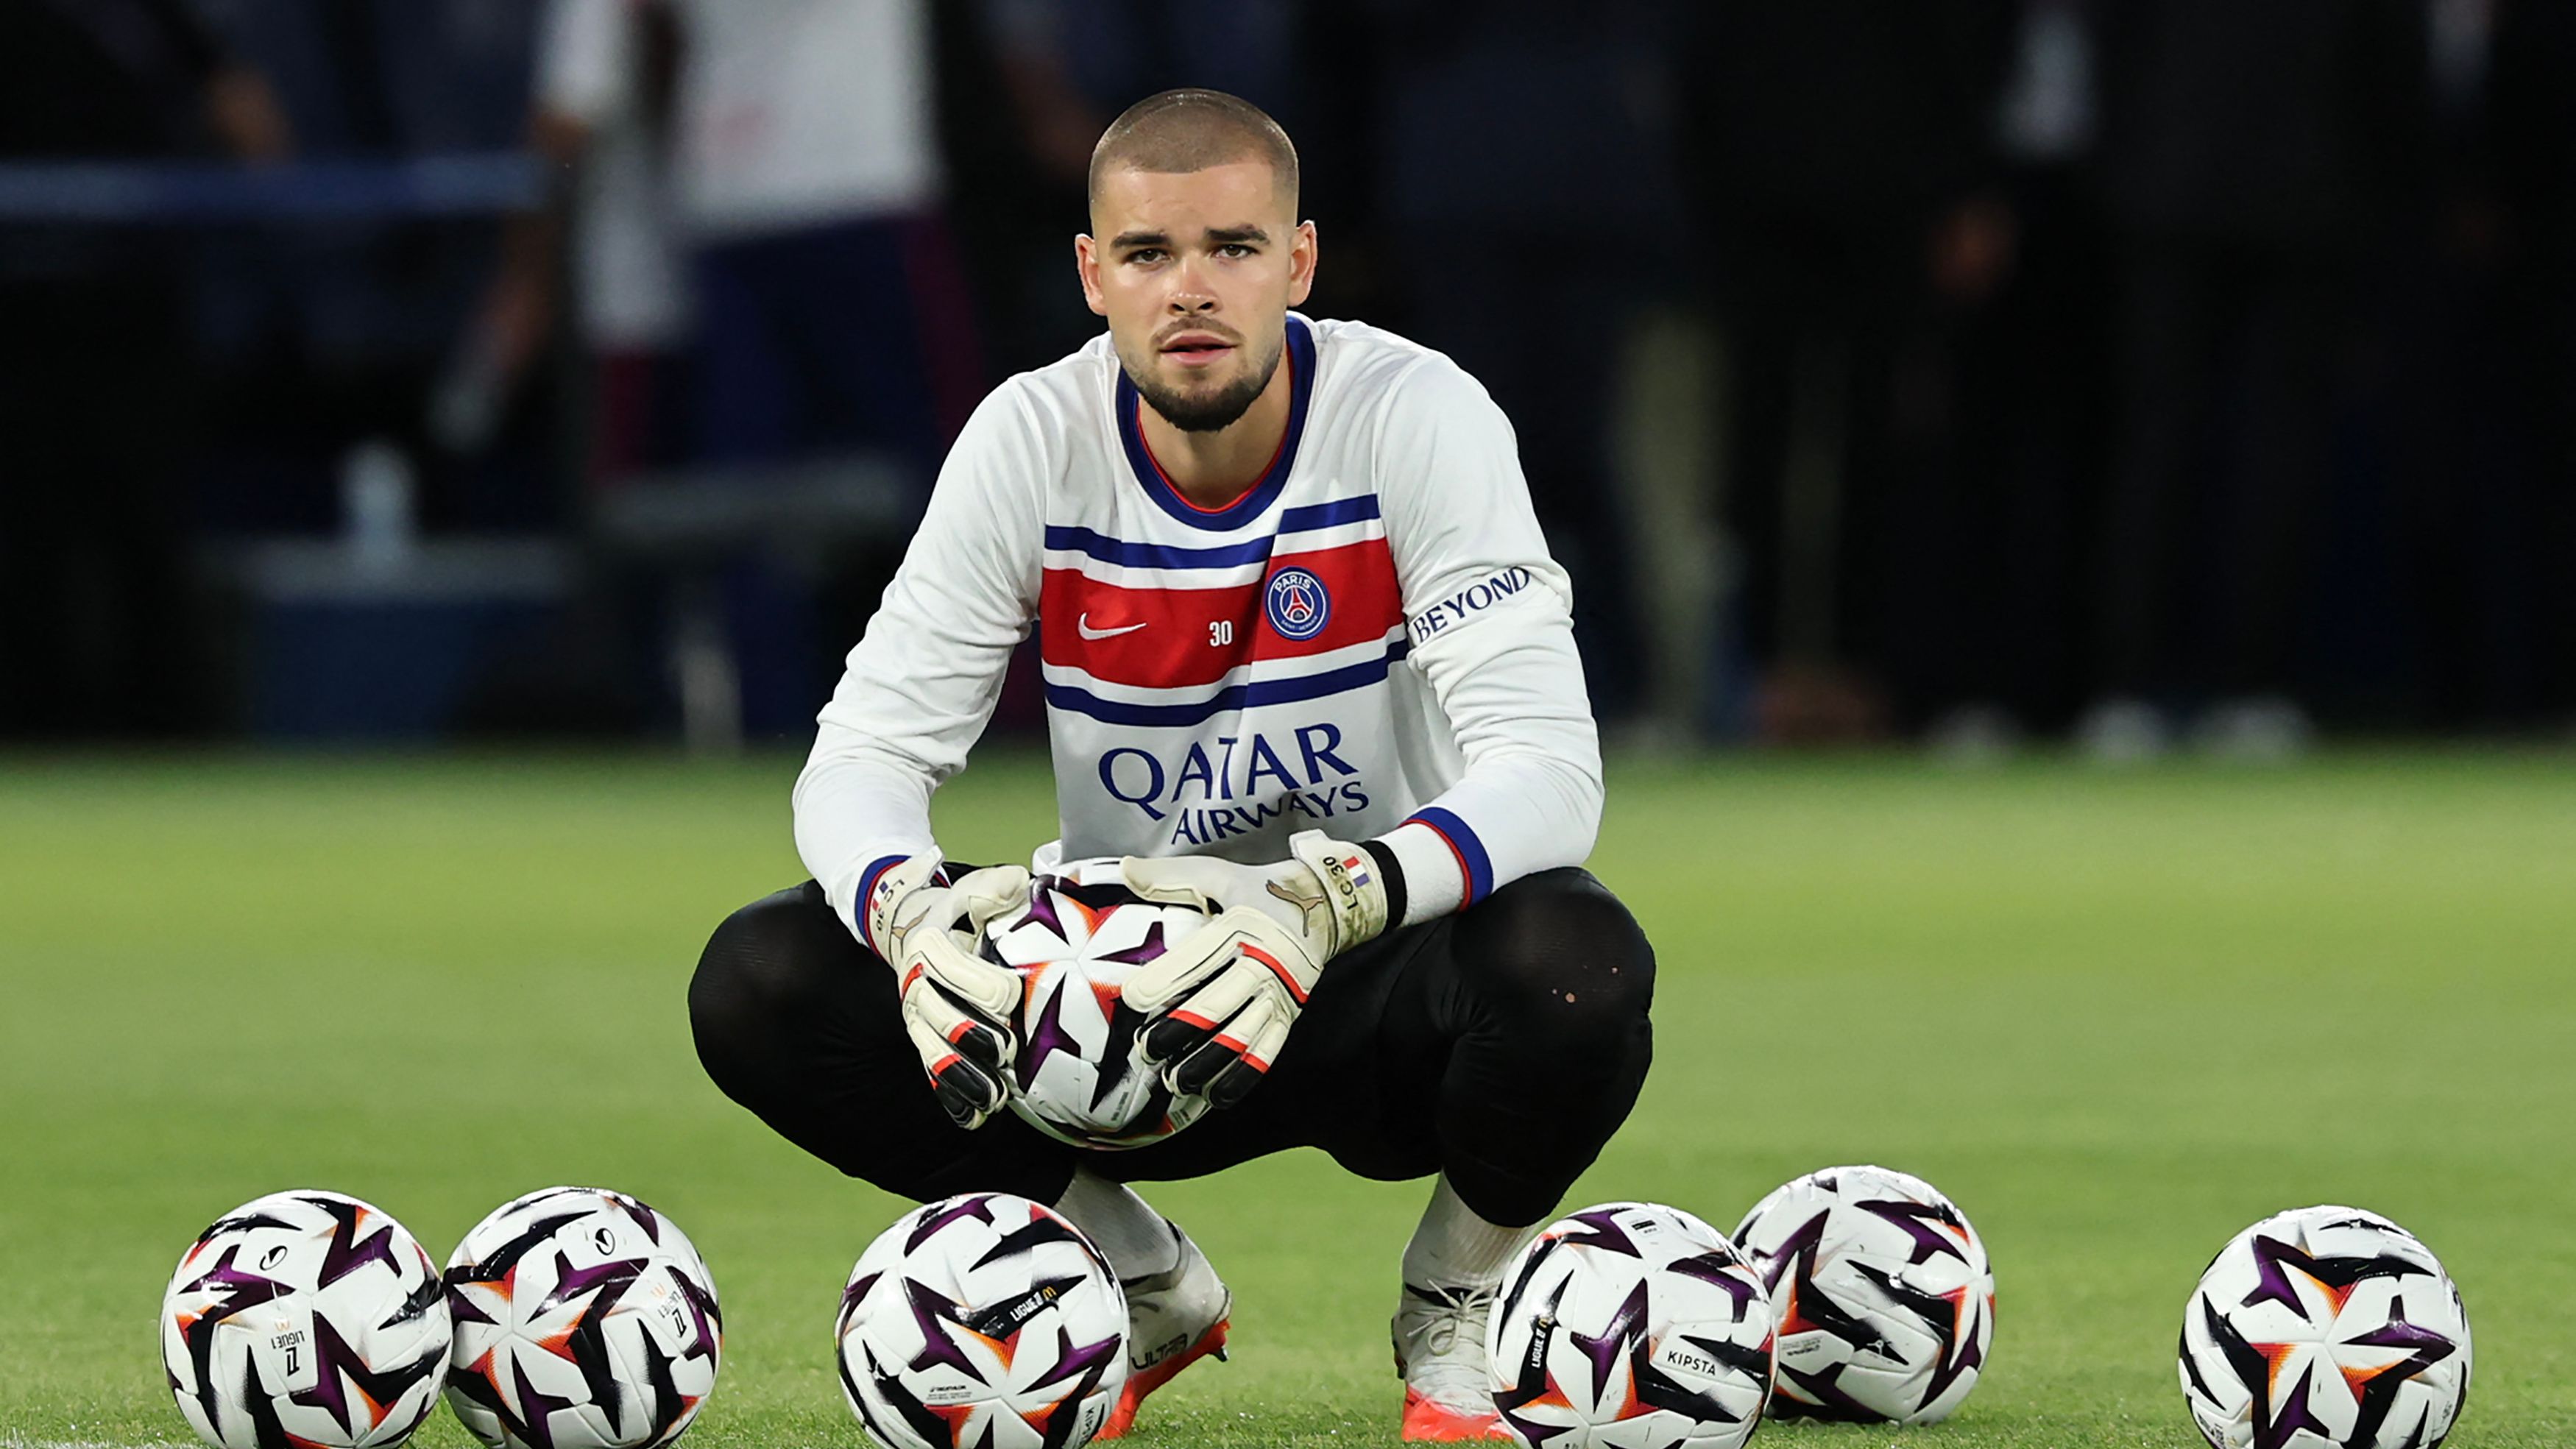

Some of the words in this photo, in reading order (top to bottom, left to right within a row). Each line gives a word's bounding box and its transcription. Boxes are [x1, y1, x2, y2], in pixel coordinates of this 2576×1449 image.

[1274, 575, 1312, 592] PARIS
[1413, 566, 1530, 642] BEYOND
[1209, 620, 1232, 647] 30
[1098, 723, 1359, 821] QATAR
[1171, 782, 1369, 845] AIRWAYS
[1667, 1350, 1716, 1376] KIPSTA
